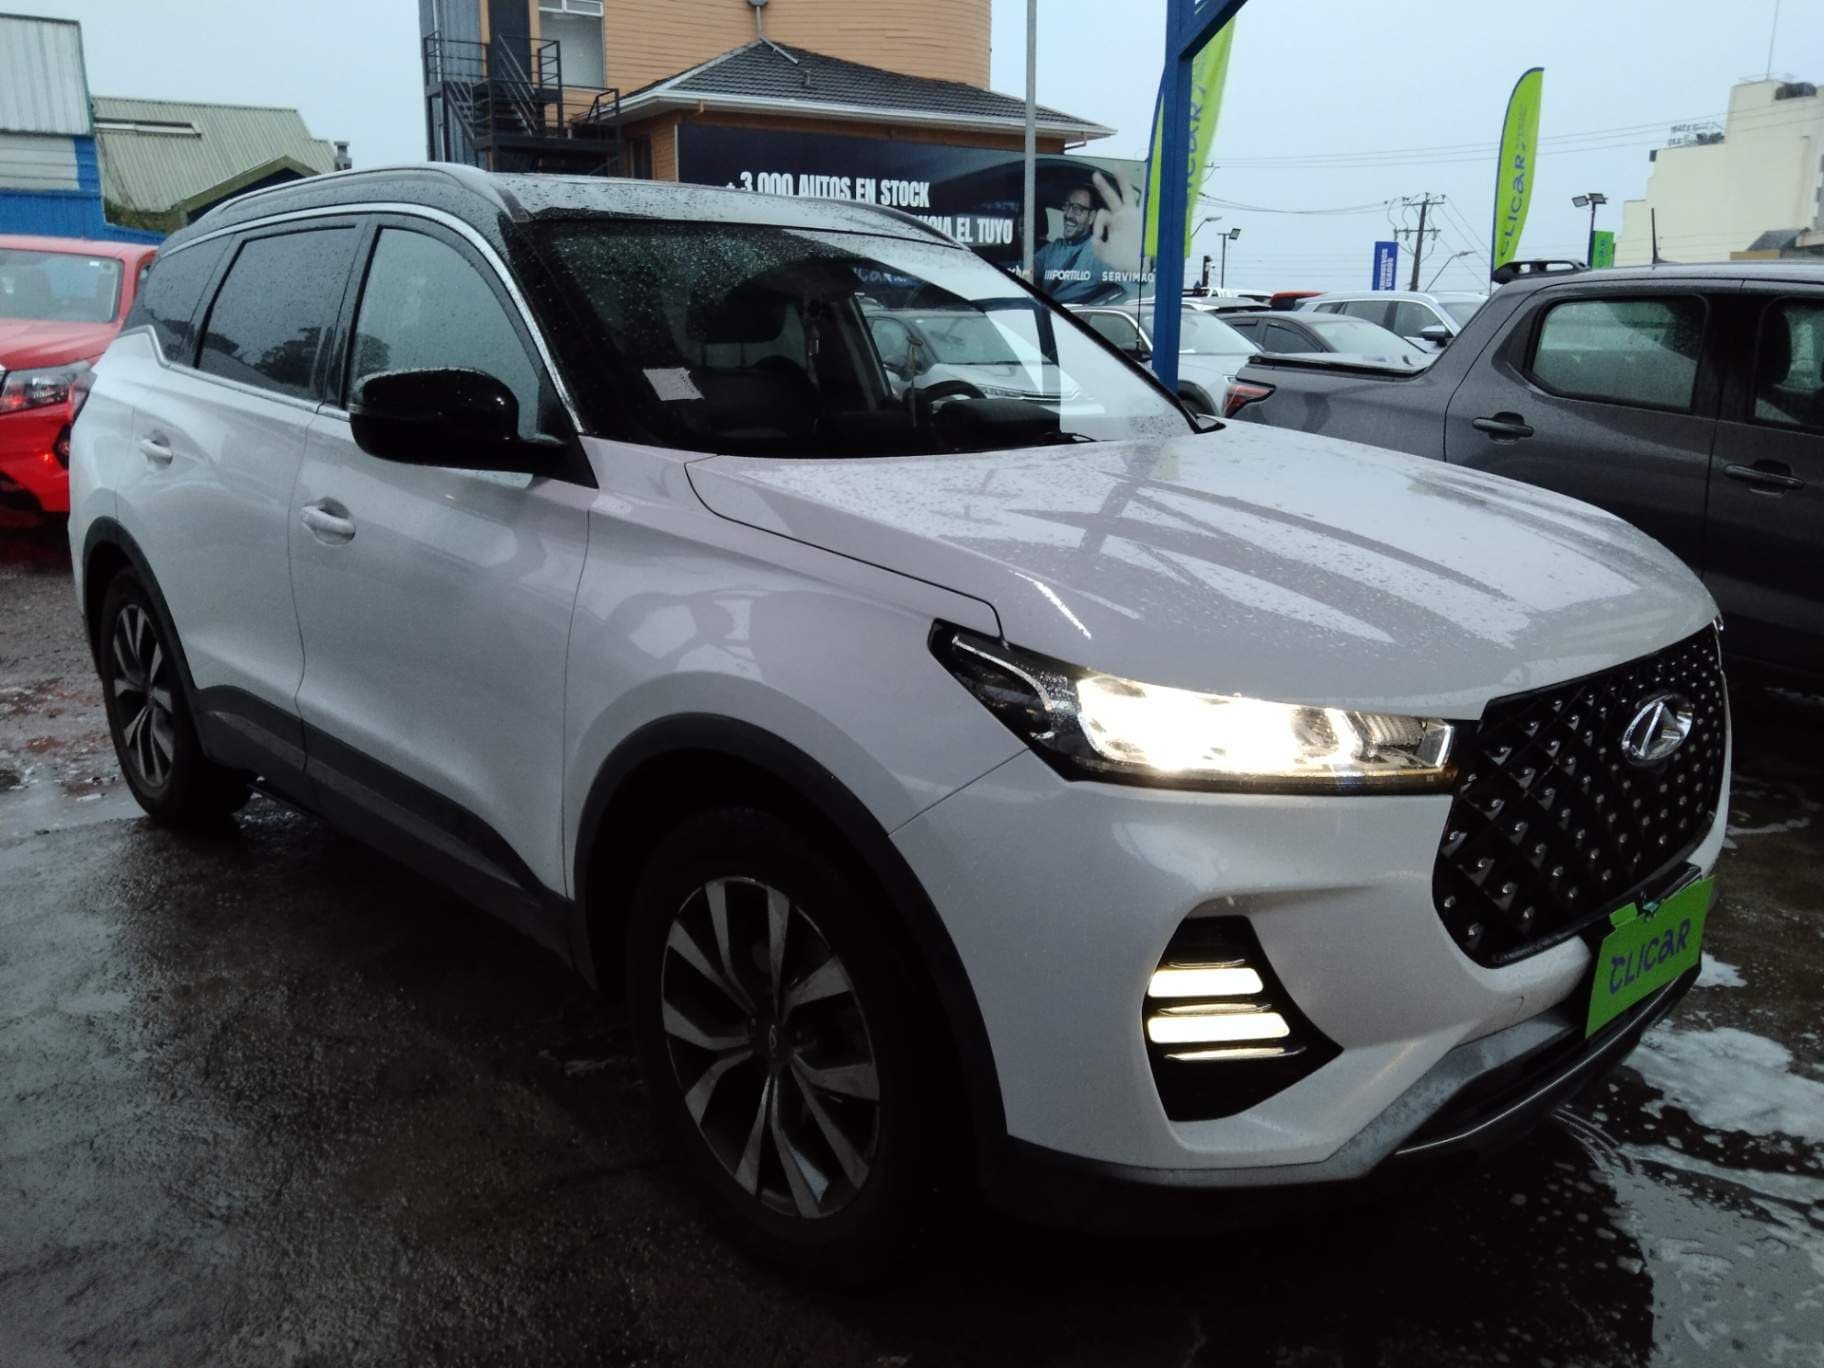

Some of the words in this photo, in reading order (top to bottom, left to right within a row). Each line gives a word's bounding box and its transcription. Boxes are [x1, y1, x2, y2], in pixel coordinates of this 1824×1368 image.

[798, 174, 852, 200] AUTOS
[855, 177, 876, 204] EN
[880, 178, 931, 208] STOCK
[956, 216, 973, 243] EL
[977, 217, 1014, 245] TUYO
[1051, 269, 1092, 282] PORTILLO
